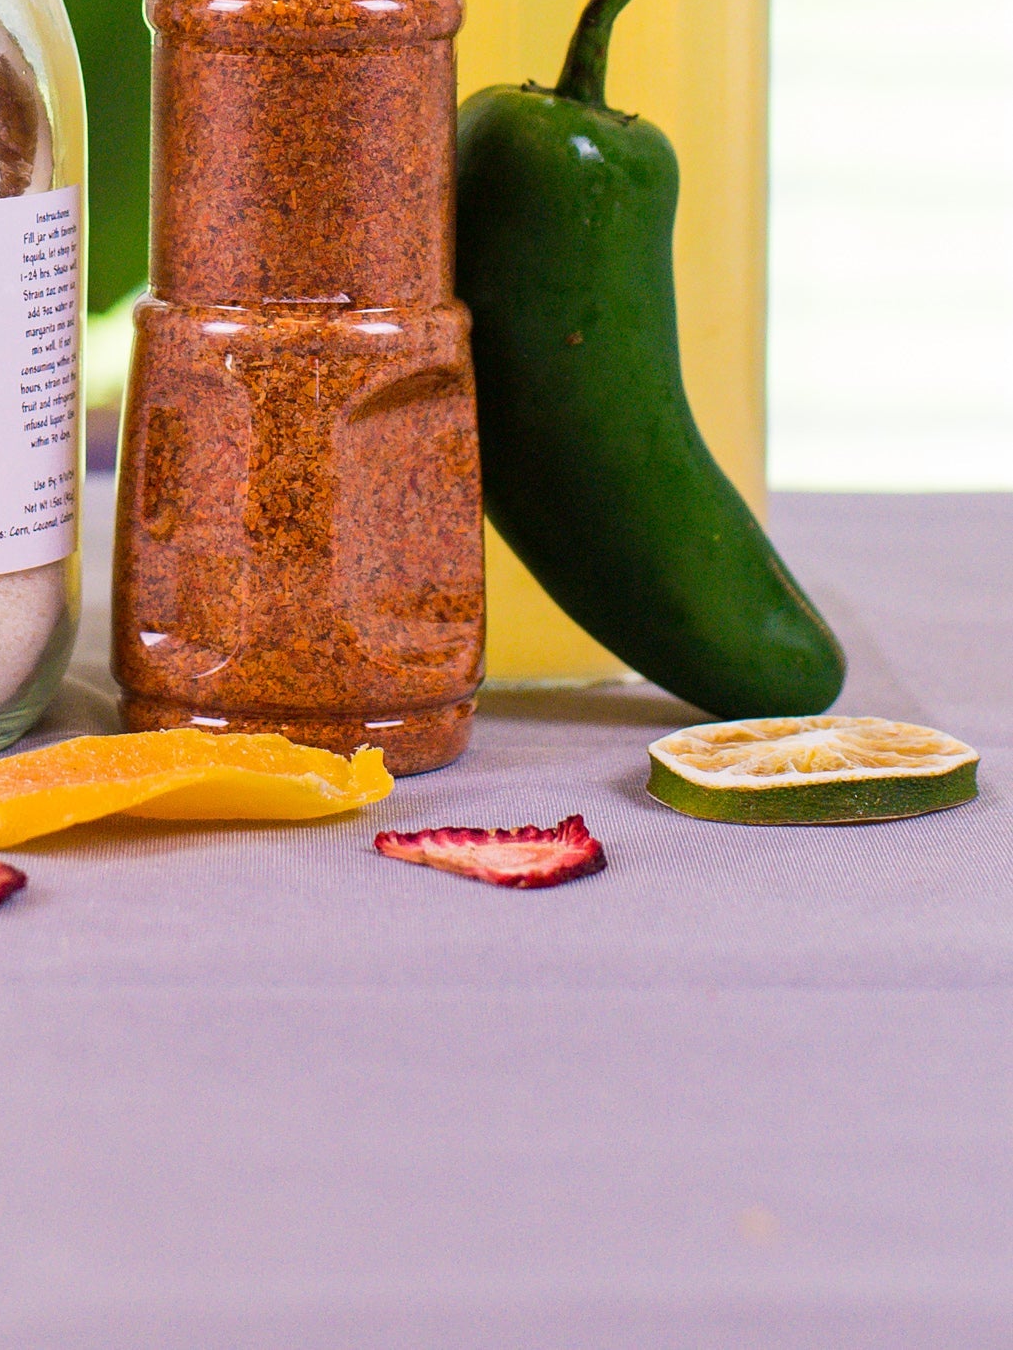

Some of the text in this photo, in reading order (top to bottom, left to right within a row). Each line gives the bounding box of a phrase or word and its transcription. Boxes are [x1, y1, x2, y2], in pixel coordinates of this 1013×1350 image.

[23, 232, 35, 244] Fill
[36, 232, 46, 245] jar
[48, 247, 56, 258] let
[23, 289, 44, 301] Strain
[28, 306, 41, 319] add
[25, 323, 55, 340] margarita
[21, 401, 37, 413] fruit
[39, 396, 51, 410] and
[23, 415, 48, 431] infused
[34, 480, 46, 491] Use
[24, 503, 37, 514] Net
